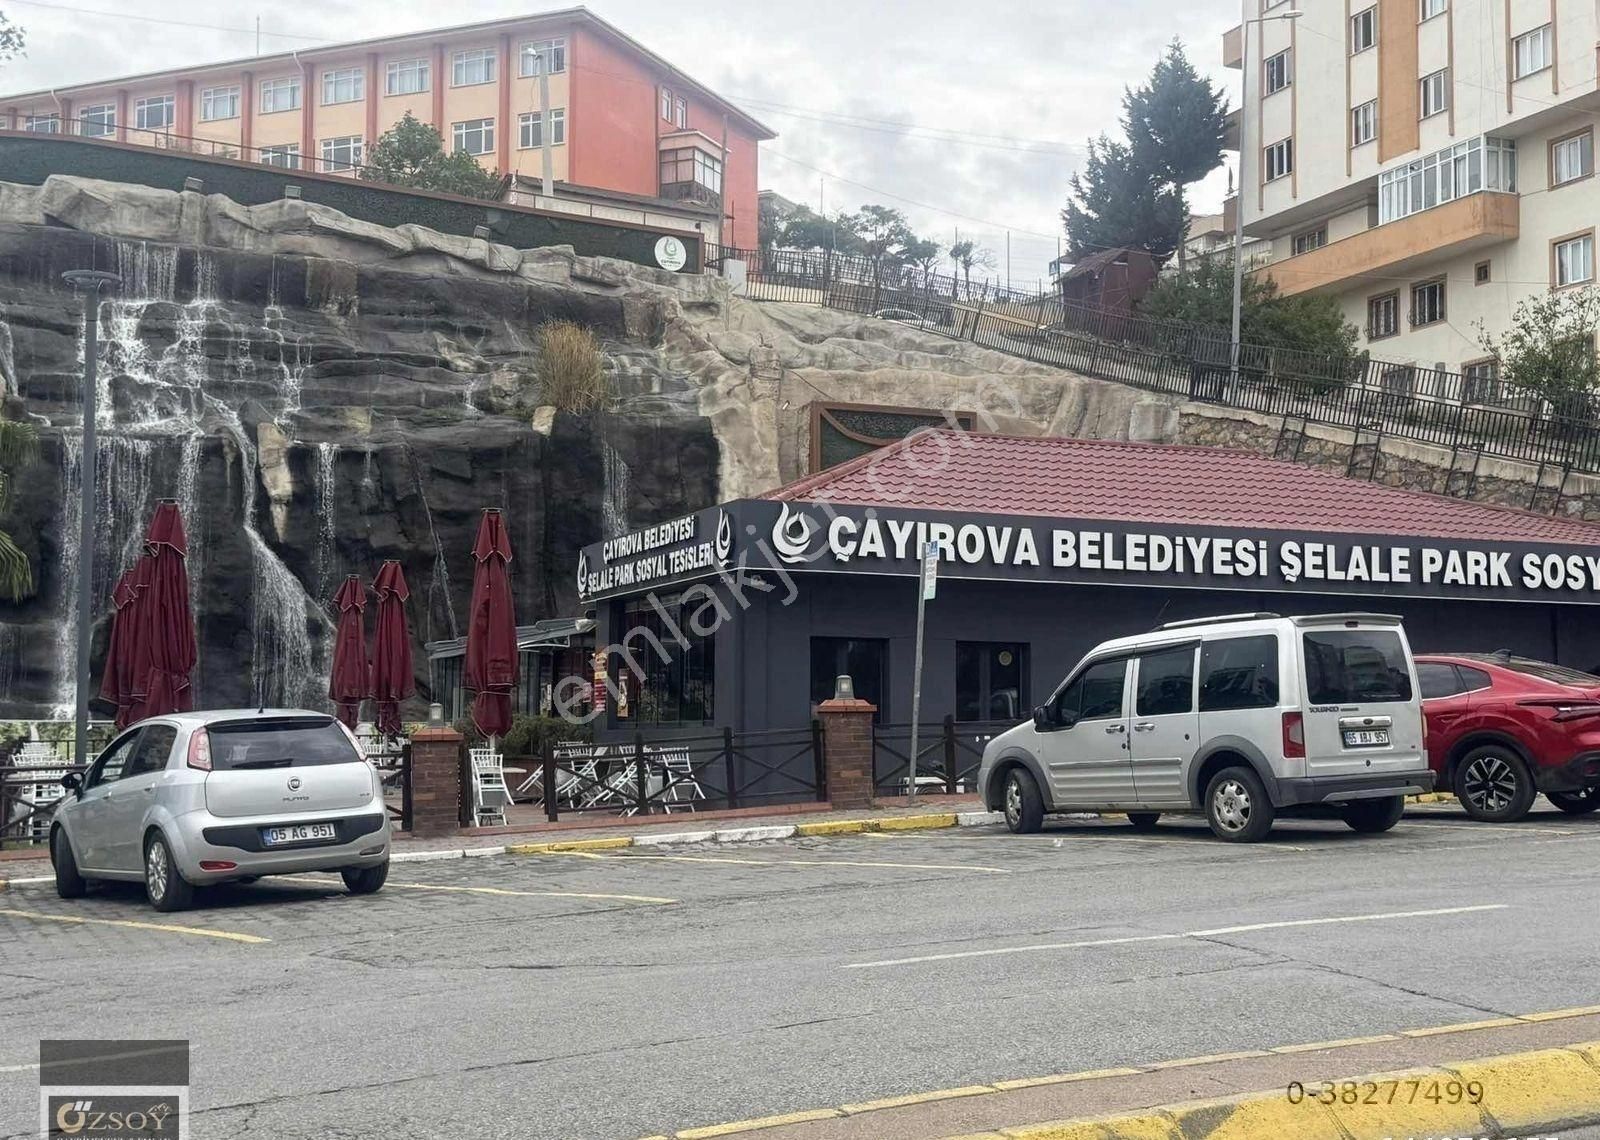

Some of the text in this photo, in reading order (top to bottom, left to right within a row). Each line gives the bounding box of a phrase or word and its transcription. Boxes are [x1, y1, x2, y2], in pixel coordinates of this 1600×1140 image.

[603, 532, 643, 564] ÇAYIROVA
[828, 516, 1040, 567] ÇAYIROVA
[1280, 540, 1411, 584] ŞELALE
[1422, 548, 1513, 587] PARK
[1522, 553, 1600, 591] SOSY
[587, 568, 614, 596] ŞELALE
[614, 561, 635, 587] PARK
[636, 554, 667, 582] SOSYAL
[271, 824, 333, 841] 05 AG 951
